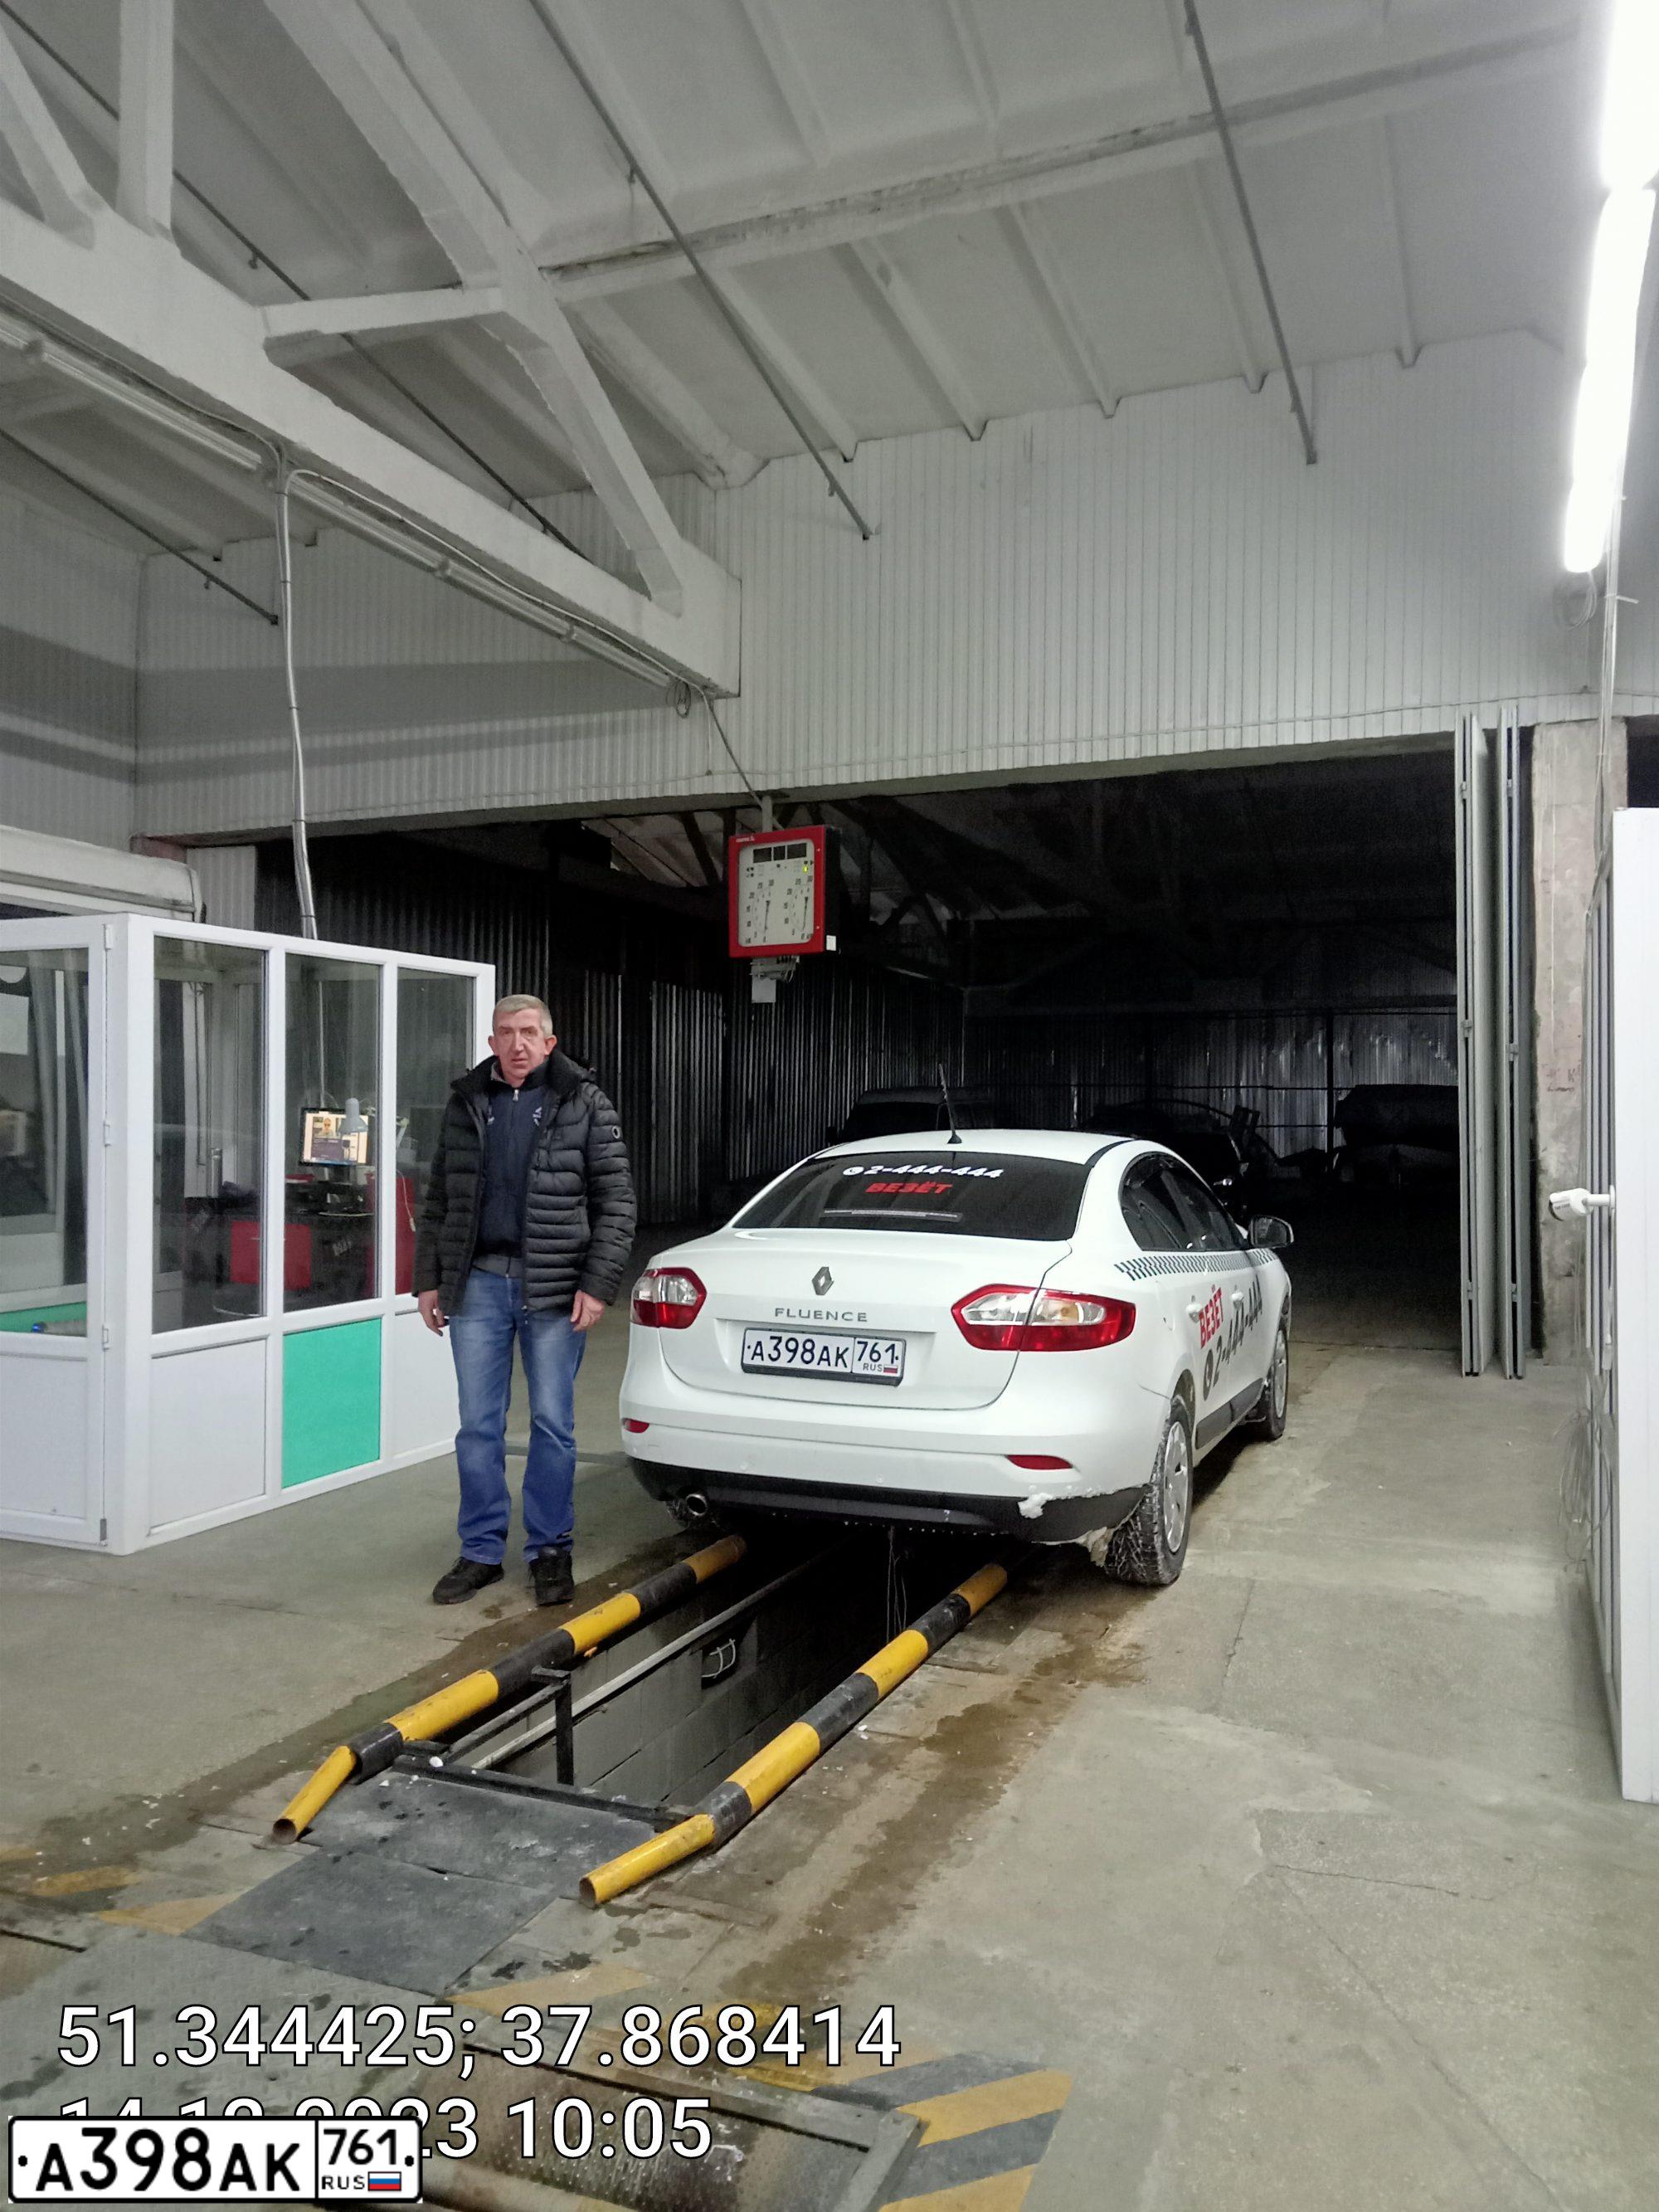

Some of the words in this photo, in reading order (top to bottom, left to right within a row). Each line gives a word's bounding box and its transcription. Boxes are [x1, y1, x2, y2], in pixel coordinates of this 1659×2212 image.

[864, 1165, 1004, 1177] 2-444-444
[775, 1308, 868, 1322] FLUENCE
[857, 1341, 898, 1364] 761
[863, 1363, 883, 1372] RUS
